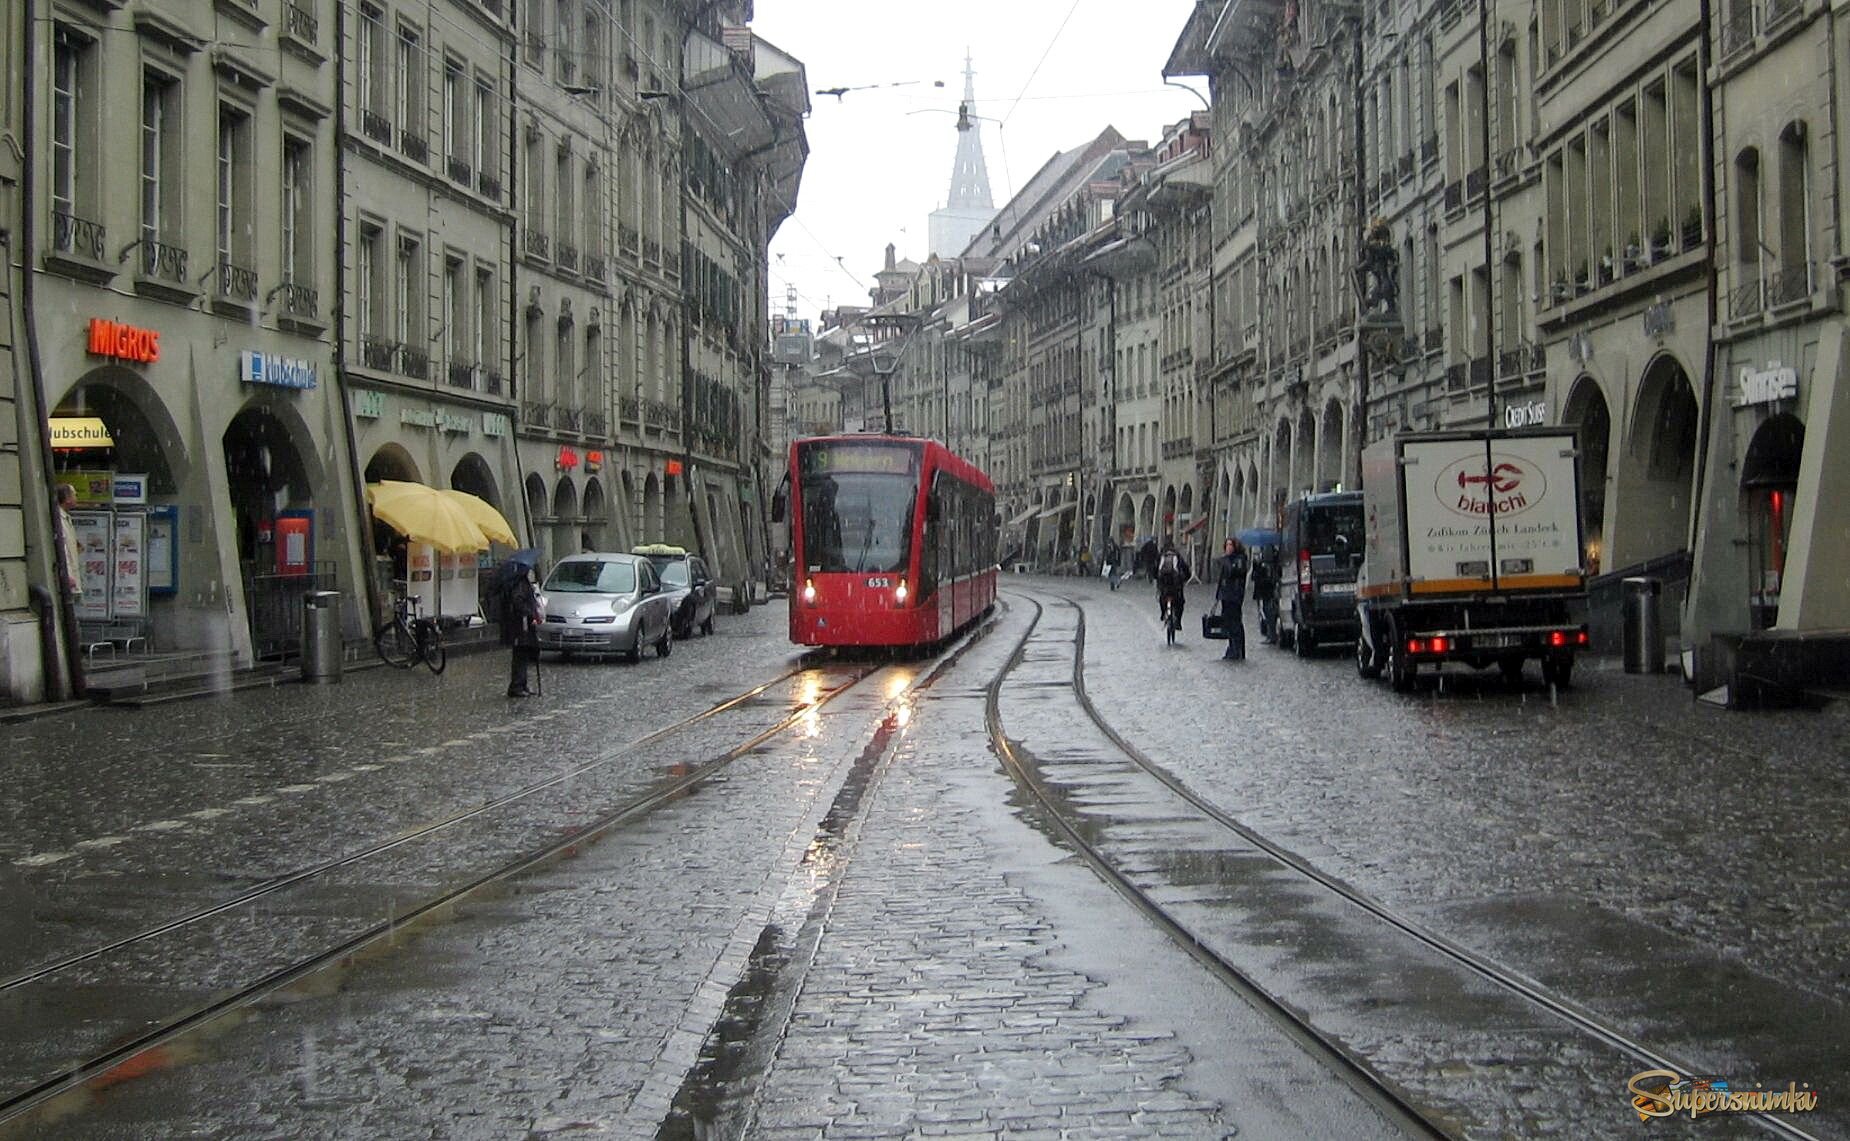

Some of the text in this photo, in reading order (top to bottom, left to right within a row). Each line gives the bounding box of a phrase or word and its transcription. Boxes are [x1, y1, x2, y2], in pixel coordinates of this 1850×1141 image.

[89, 317, 160, 363] MIGROS
[1457, 492, 1527, 515] bianchi
[868, 577, 888, 588] 653
